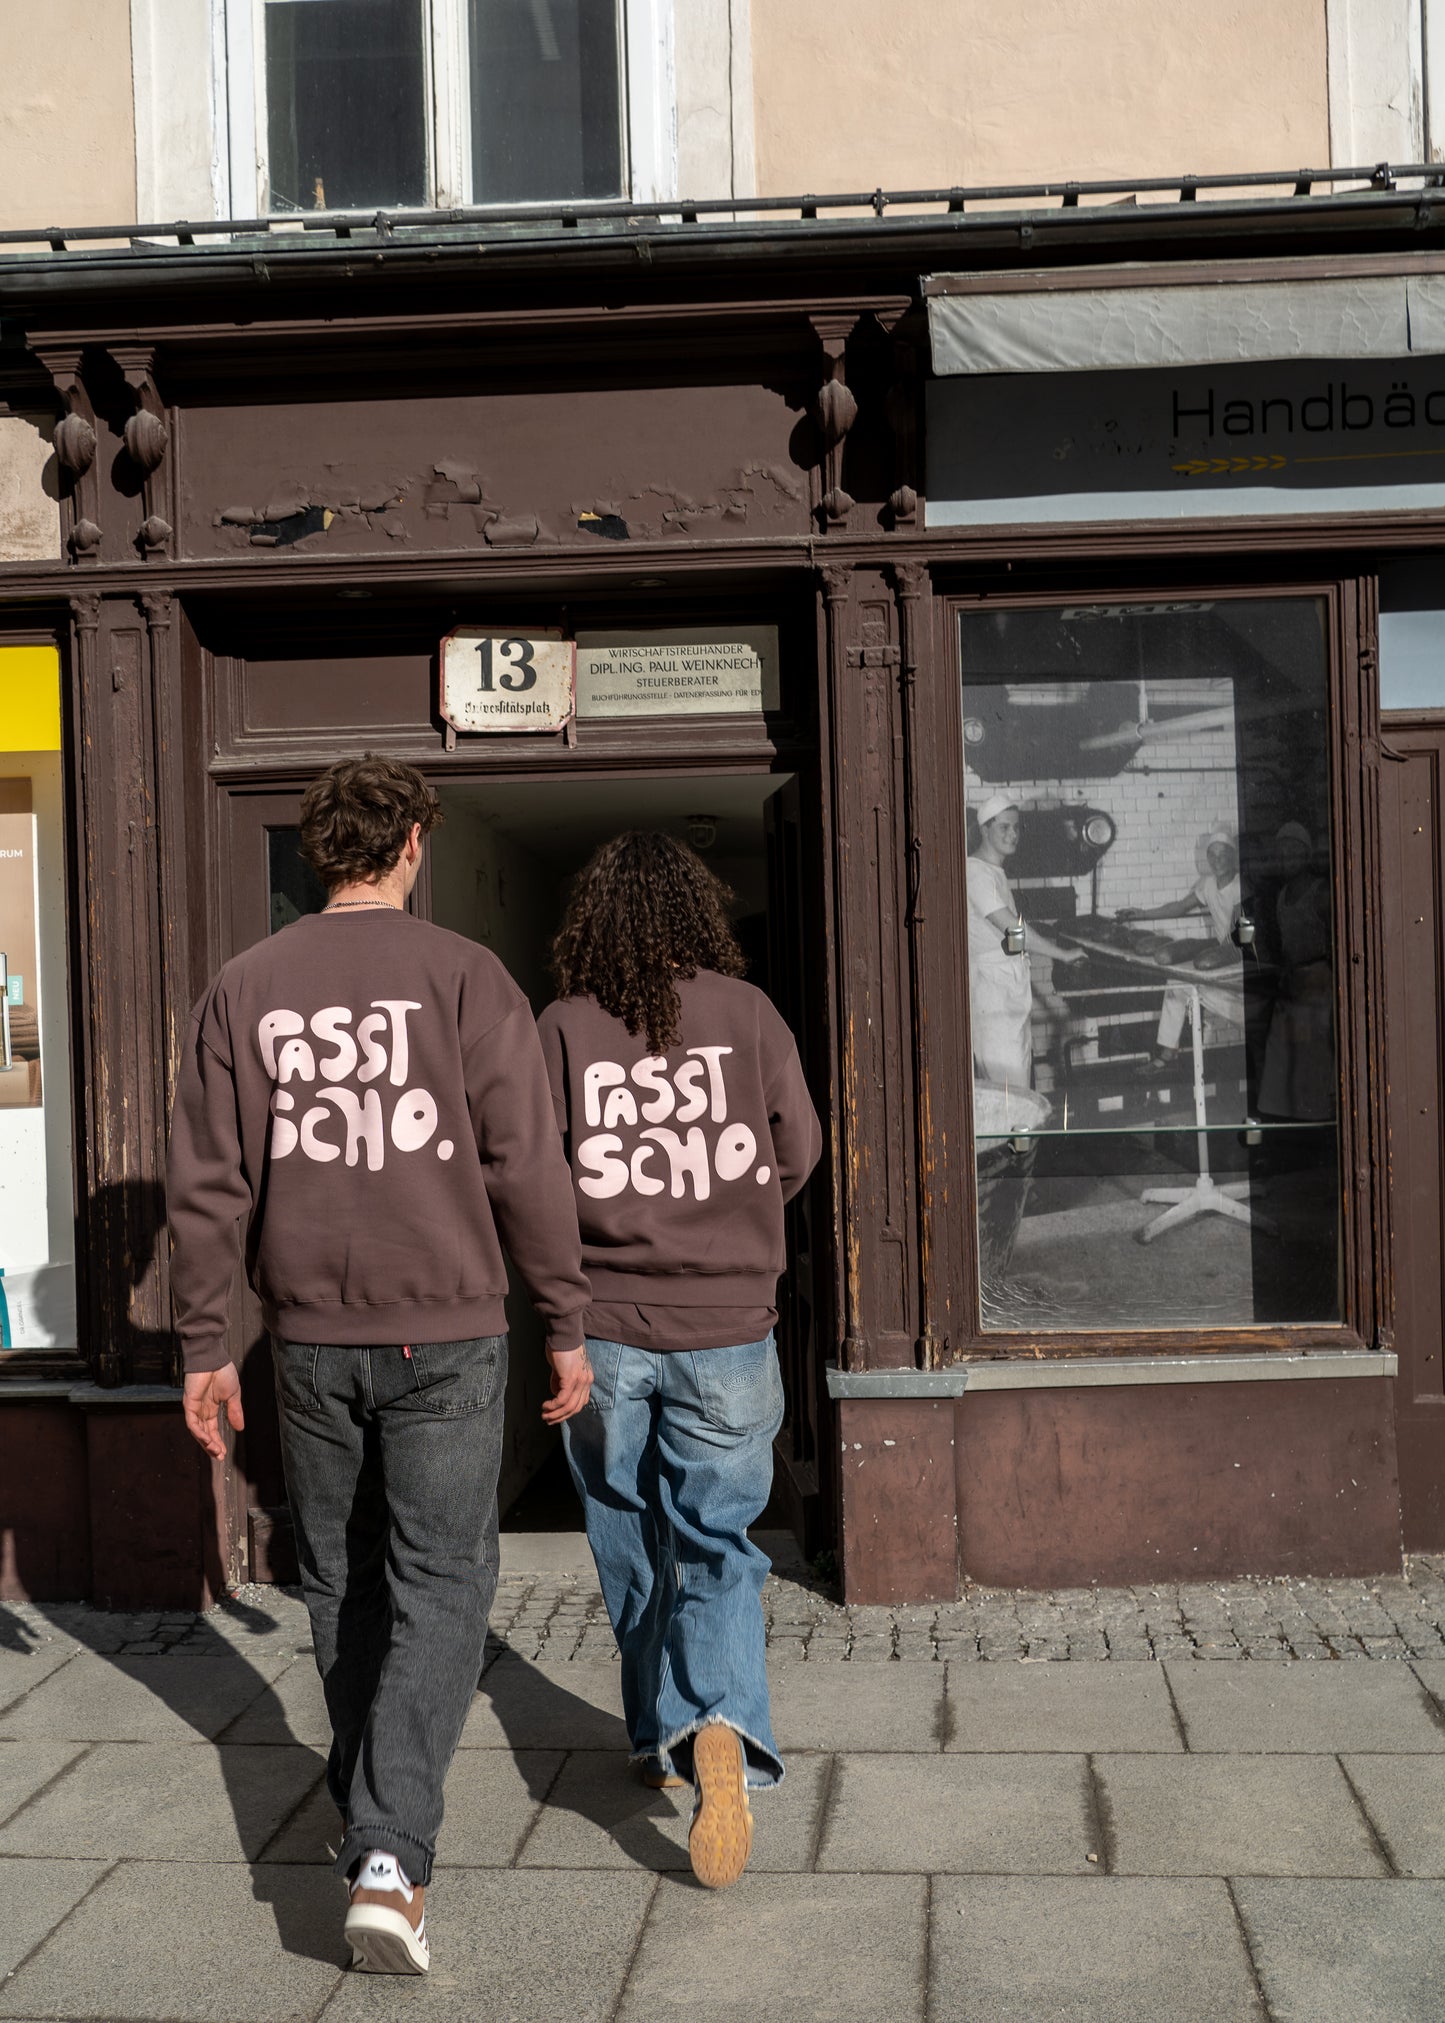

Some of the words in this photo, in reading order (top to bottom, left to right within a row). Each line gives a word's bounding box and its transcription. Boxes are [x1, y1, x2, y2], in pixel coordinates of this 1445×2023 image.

[474, 637, 537, 692] 13
[636, 676, 719, 688] STEUERBERATER
[649, 660, 679, 673] PAUL
[682, 657, 766, 671] WEINKNECHT
[735, 688, 749, 698] FÜR
[12, 980, 20, 1000] NEU
[258, 1000, 423, 1087] PASST
[584, 1046, 733, 1129] PASST
[577, 1122, 771, 1201] SCHO.
